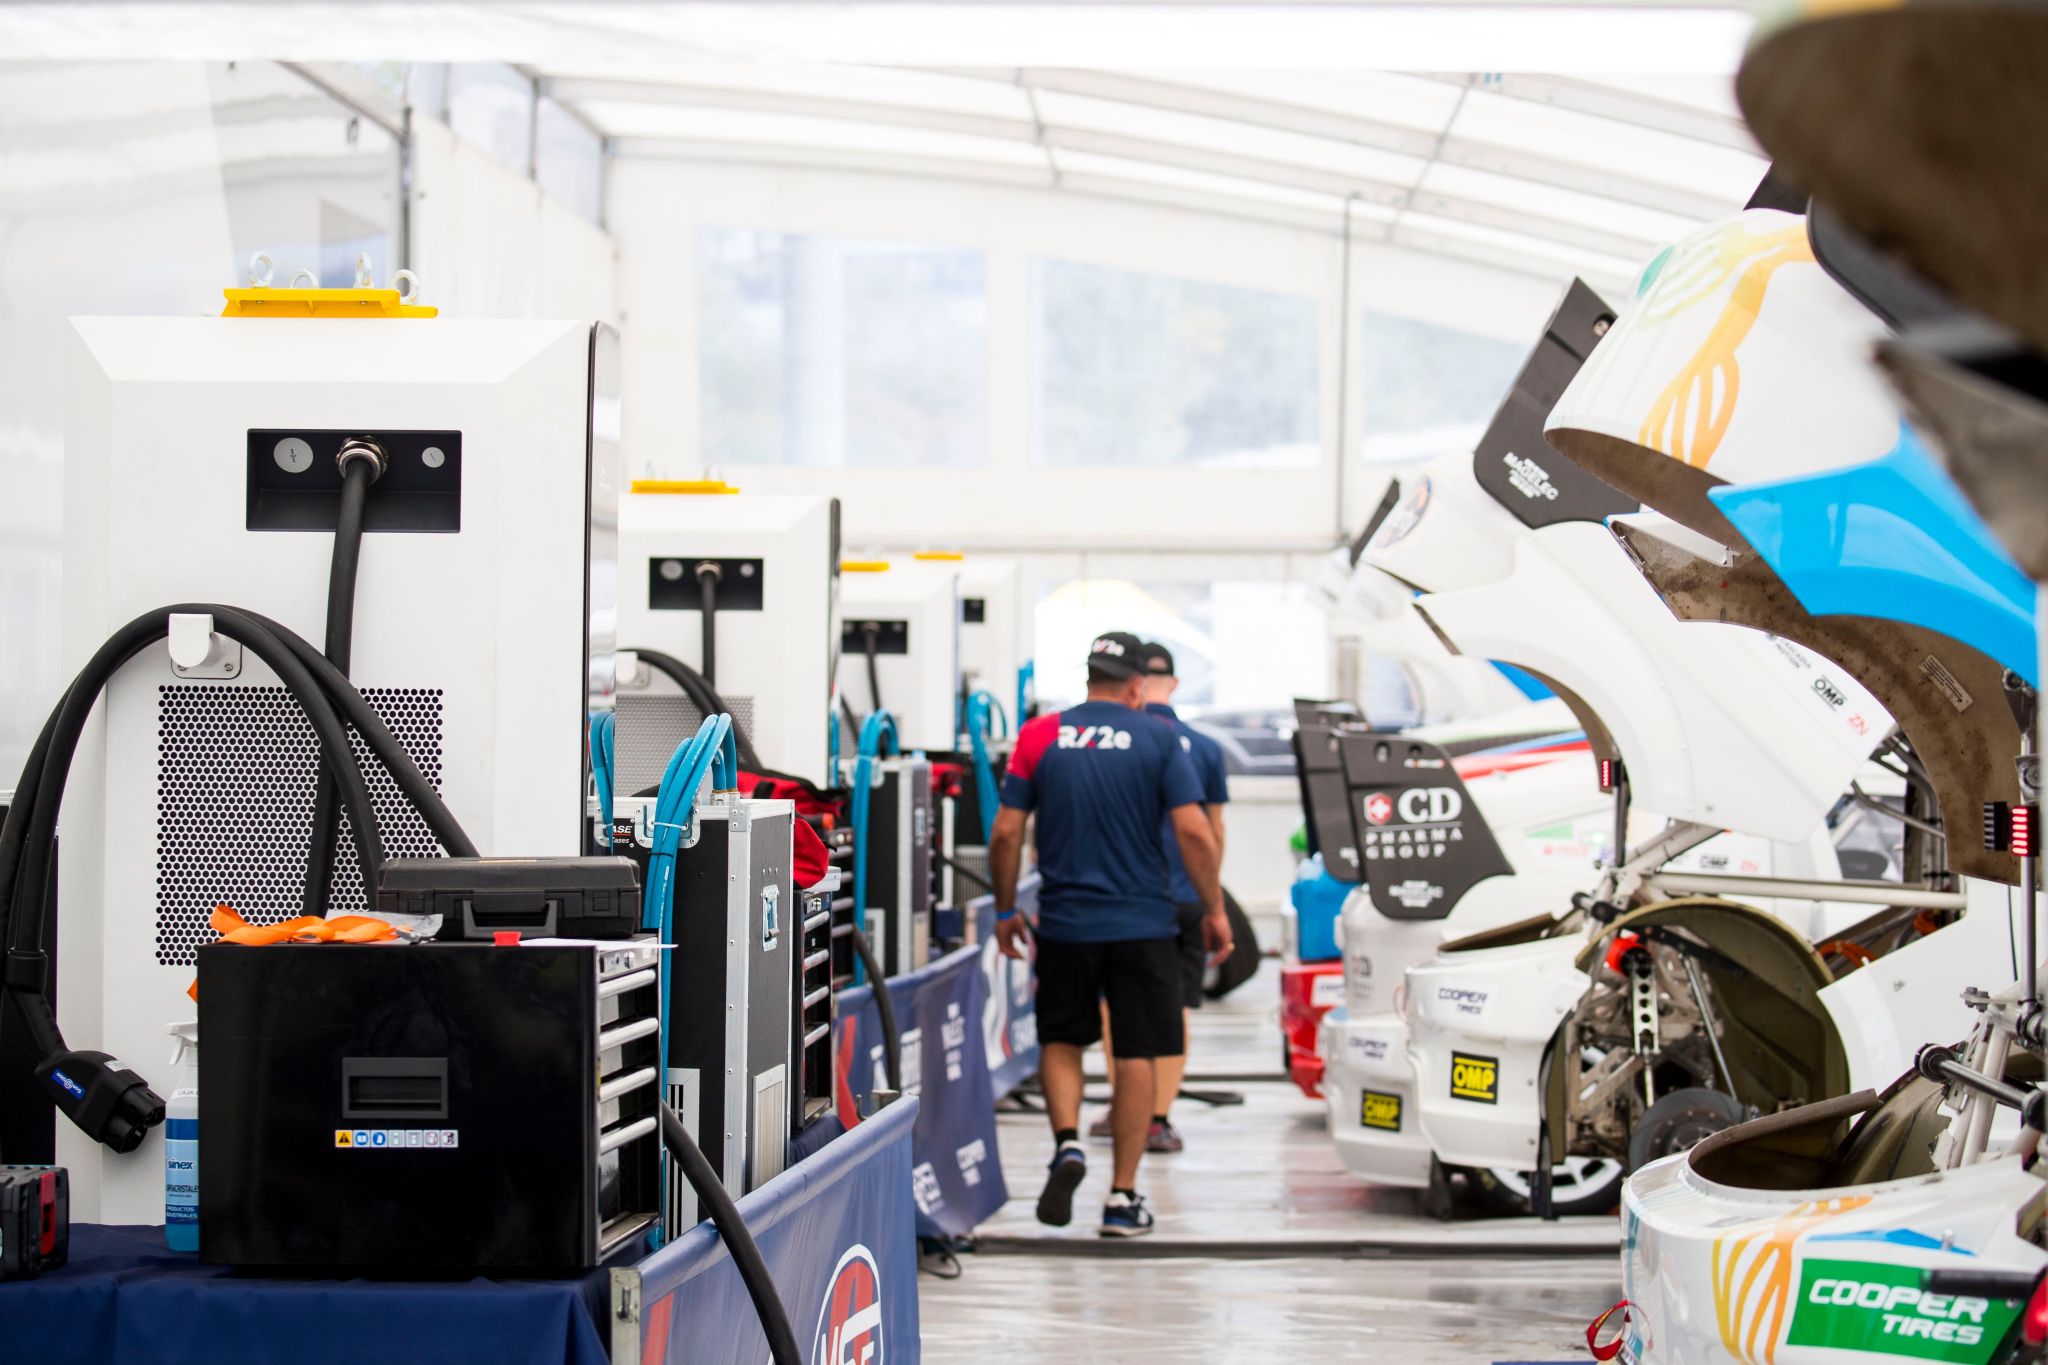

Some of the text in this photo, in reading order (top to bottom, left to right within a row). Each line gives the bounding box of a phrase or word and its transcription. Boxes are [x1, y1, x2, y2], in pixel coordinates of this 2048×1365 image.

[1814, 678, 1845, 708] OMP
[1398, 787, 1462, 823] CD
[1365, 827, 1463, 845] PHARMA
[1365, 843, 1446, 860] GROUP
[1438, 987, 1488, 1005] COOPER
[1453, 1064, 1495, 1092] OMP
[1364, 1100, 1400, 1120] OMP
[167, 1158, 194, 1170] sinex
[1809, 1278, 1990, 1323] COOPER
[1882, 1313, 1985, 1346] TIRES
